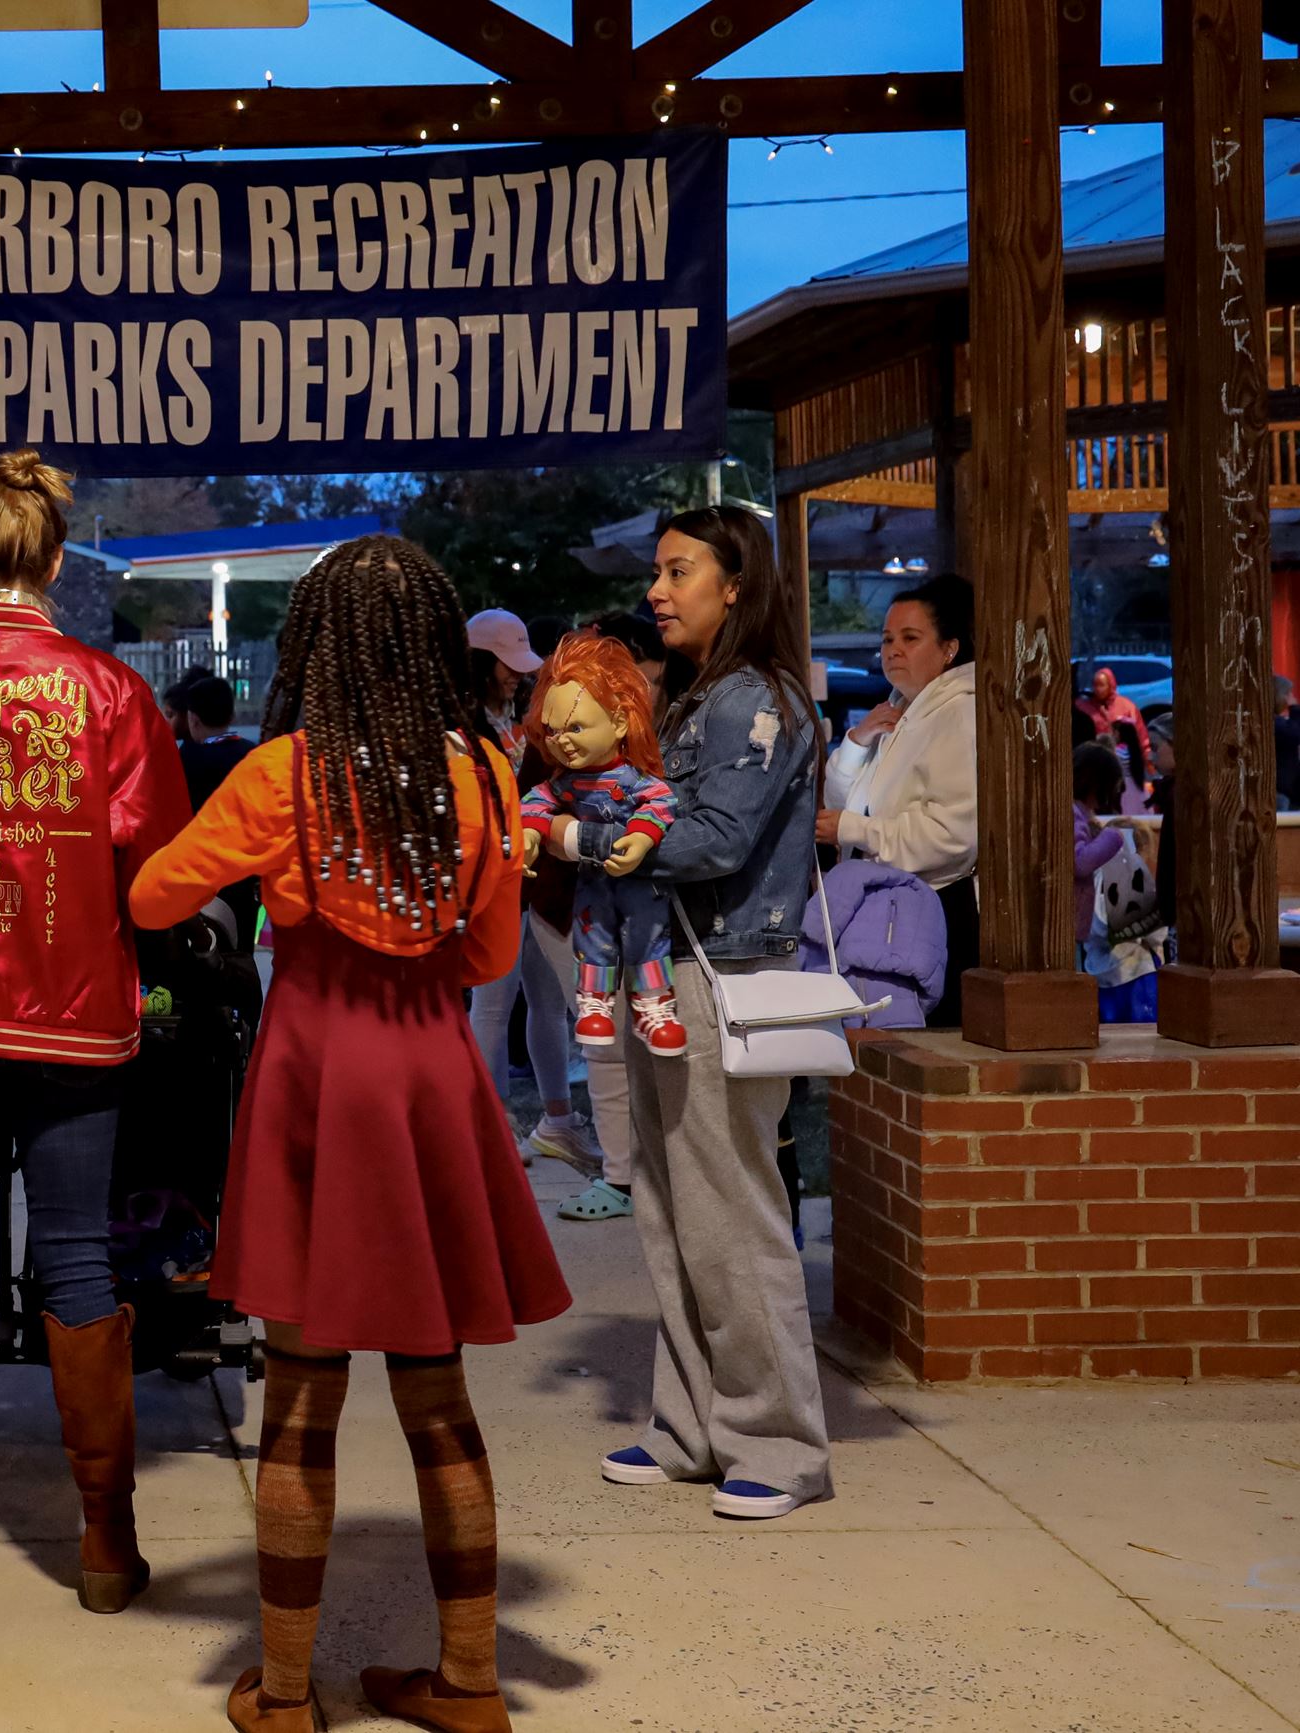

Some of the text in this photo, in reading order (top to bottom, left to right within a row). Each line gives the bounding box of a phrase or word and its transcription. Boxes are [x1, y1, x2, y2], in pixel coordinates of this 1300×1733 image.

[247, 157, 670, 292] RECREATION
[1211, 135, 1255, 362] BLACK
[240, 307, 699, 442] DEPARTMENT
[45, 847, 58, 945] 4ever
